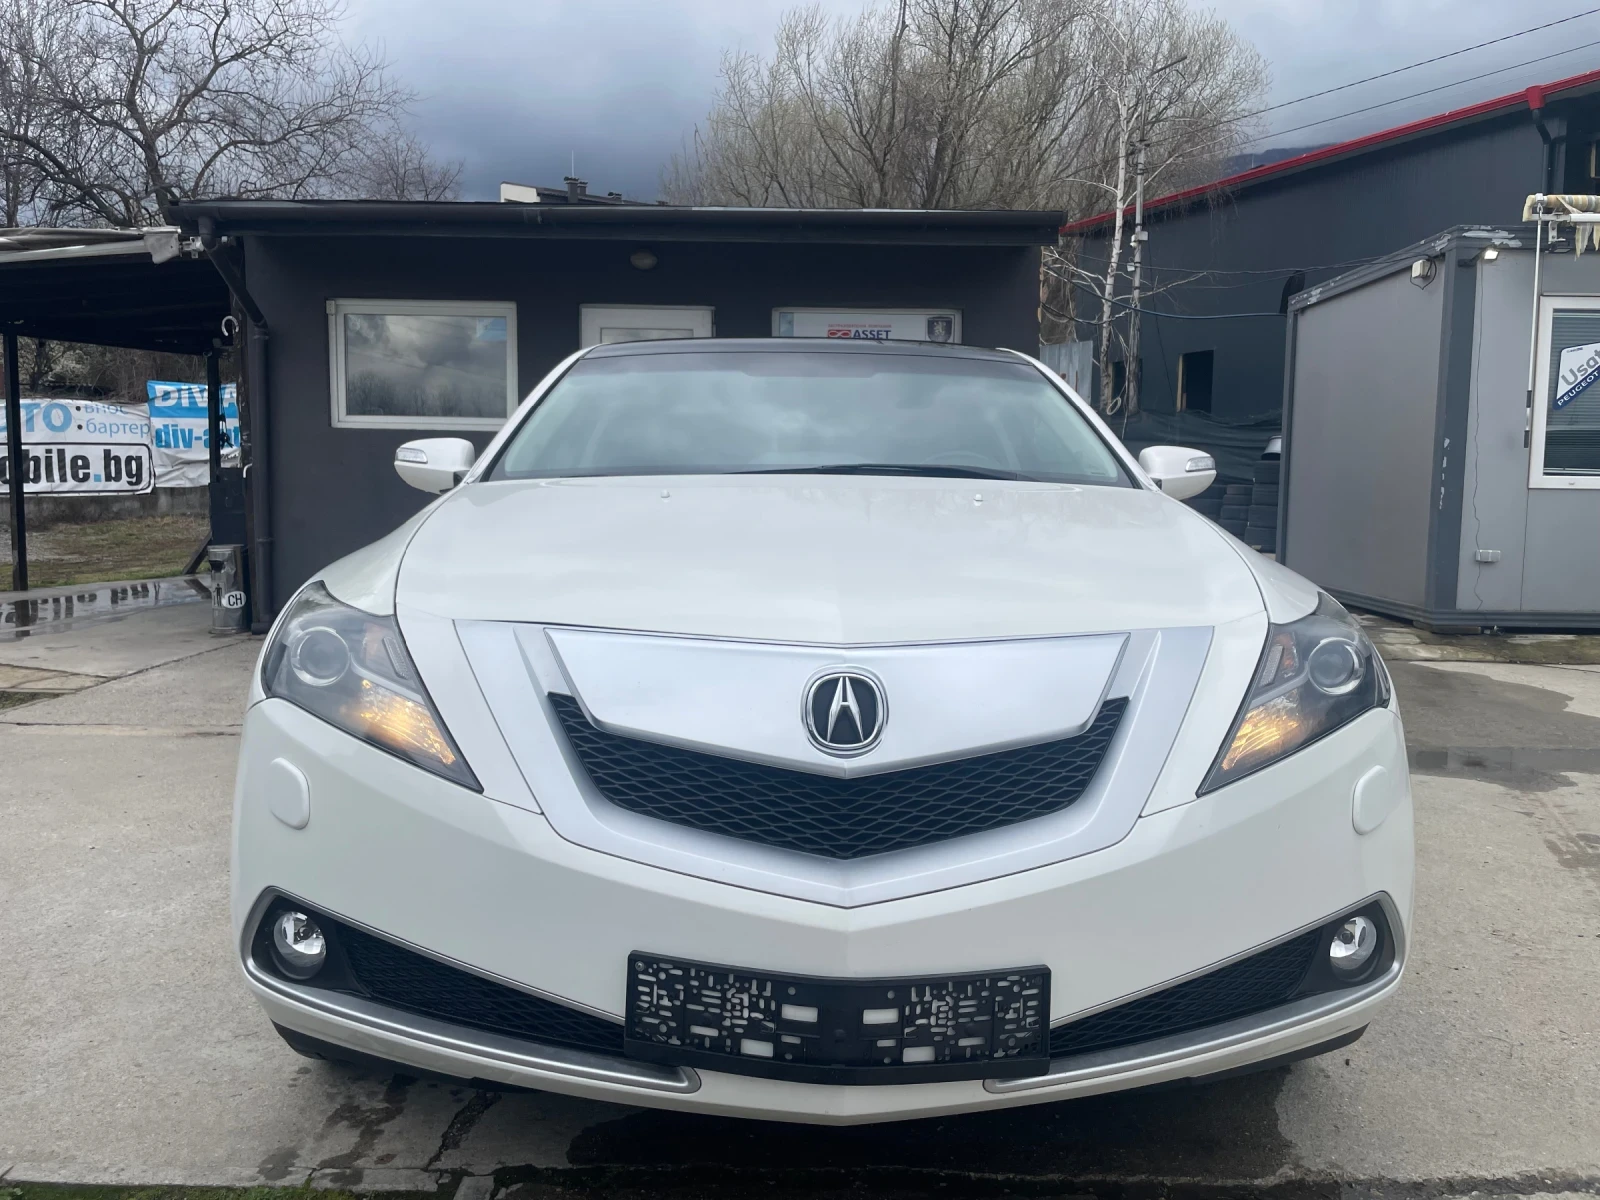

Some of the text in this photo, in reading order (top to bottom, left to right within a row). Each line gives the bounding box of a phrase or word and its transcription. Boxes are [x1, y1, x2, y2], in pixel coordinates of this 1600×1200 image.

[853, 329, 892, 339] ASSET
[1557, 370, 1599, 406] PEUGEOT
[0, 402, 73, 432] TO
[86, 418, 151, 438] бартер
[228, 593, 243, 607] CH
